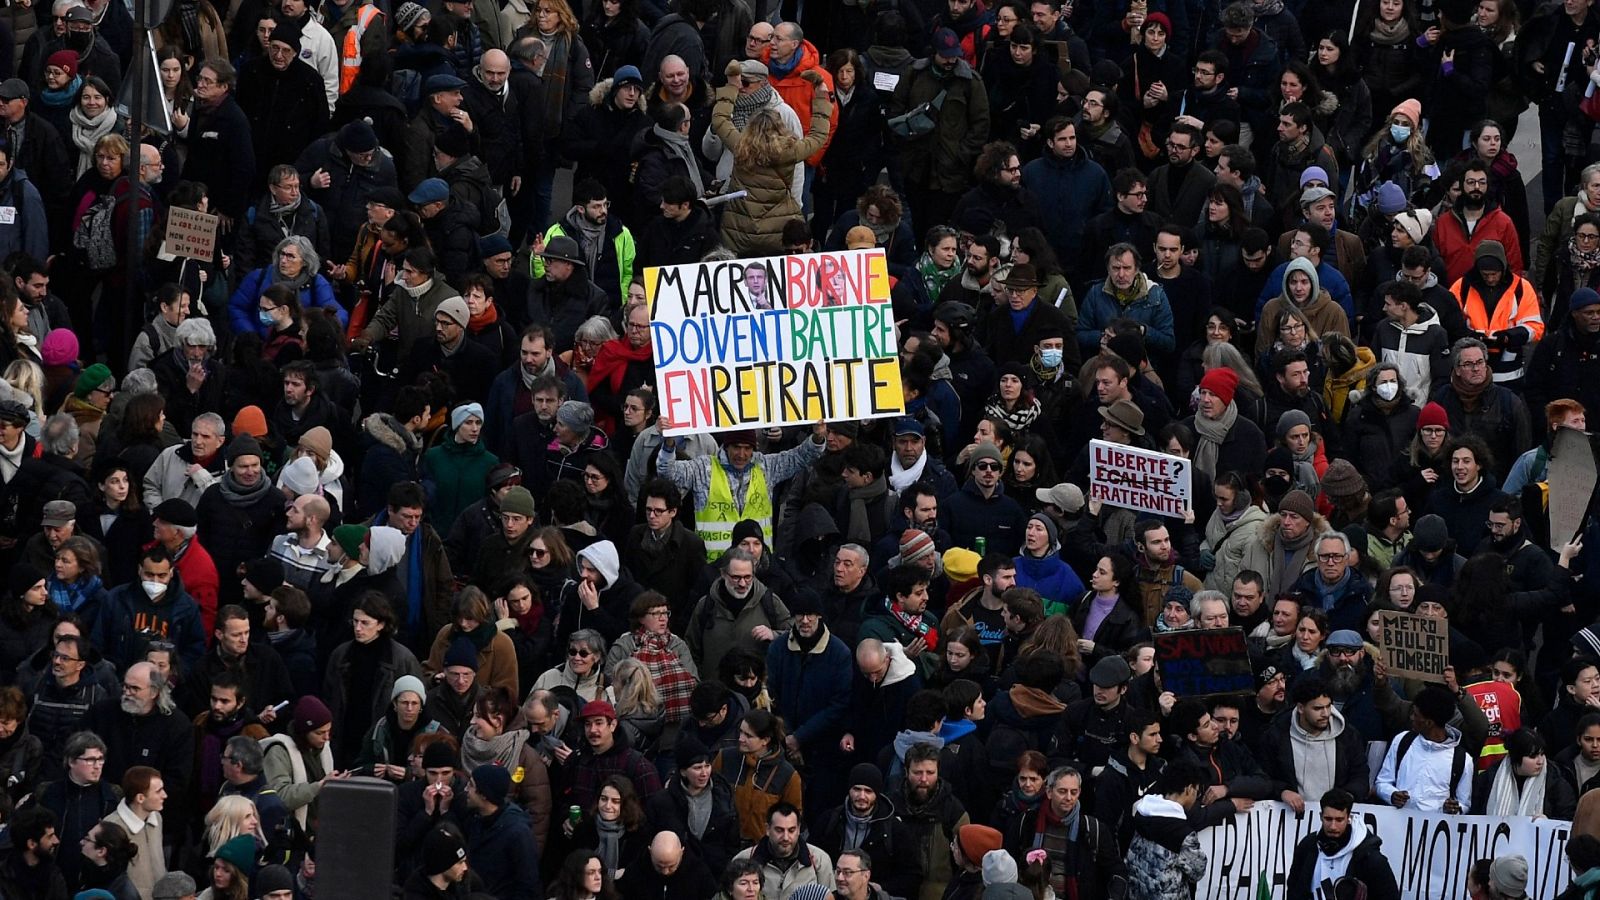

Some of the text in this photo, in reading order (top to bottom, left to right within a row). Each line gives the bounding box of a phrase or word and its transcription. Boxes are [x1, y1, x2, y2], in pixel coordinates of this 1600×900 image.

[169, 231, 210, 247] MON CORPS
[651, 253, 890, 321] MACRN BORNE
[790, 303, 899, 362] BATTRE
[665, 367, 713, 428] EN
[1383, 614, 1437, 634] METRO
[1384, 628, 1446, 654] BOULOT
[1484, 693, 1497, 704] 93
